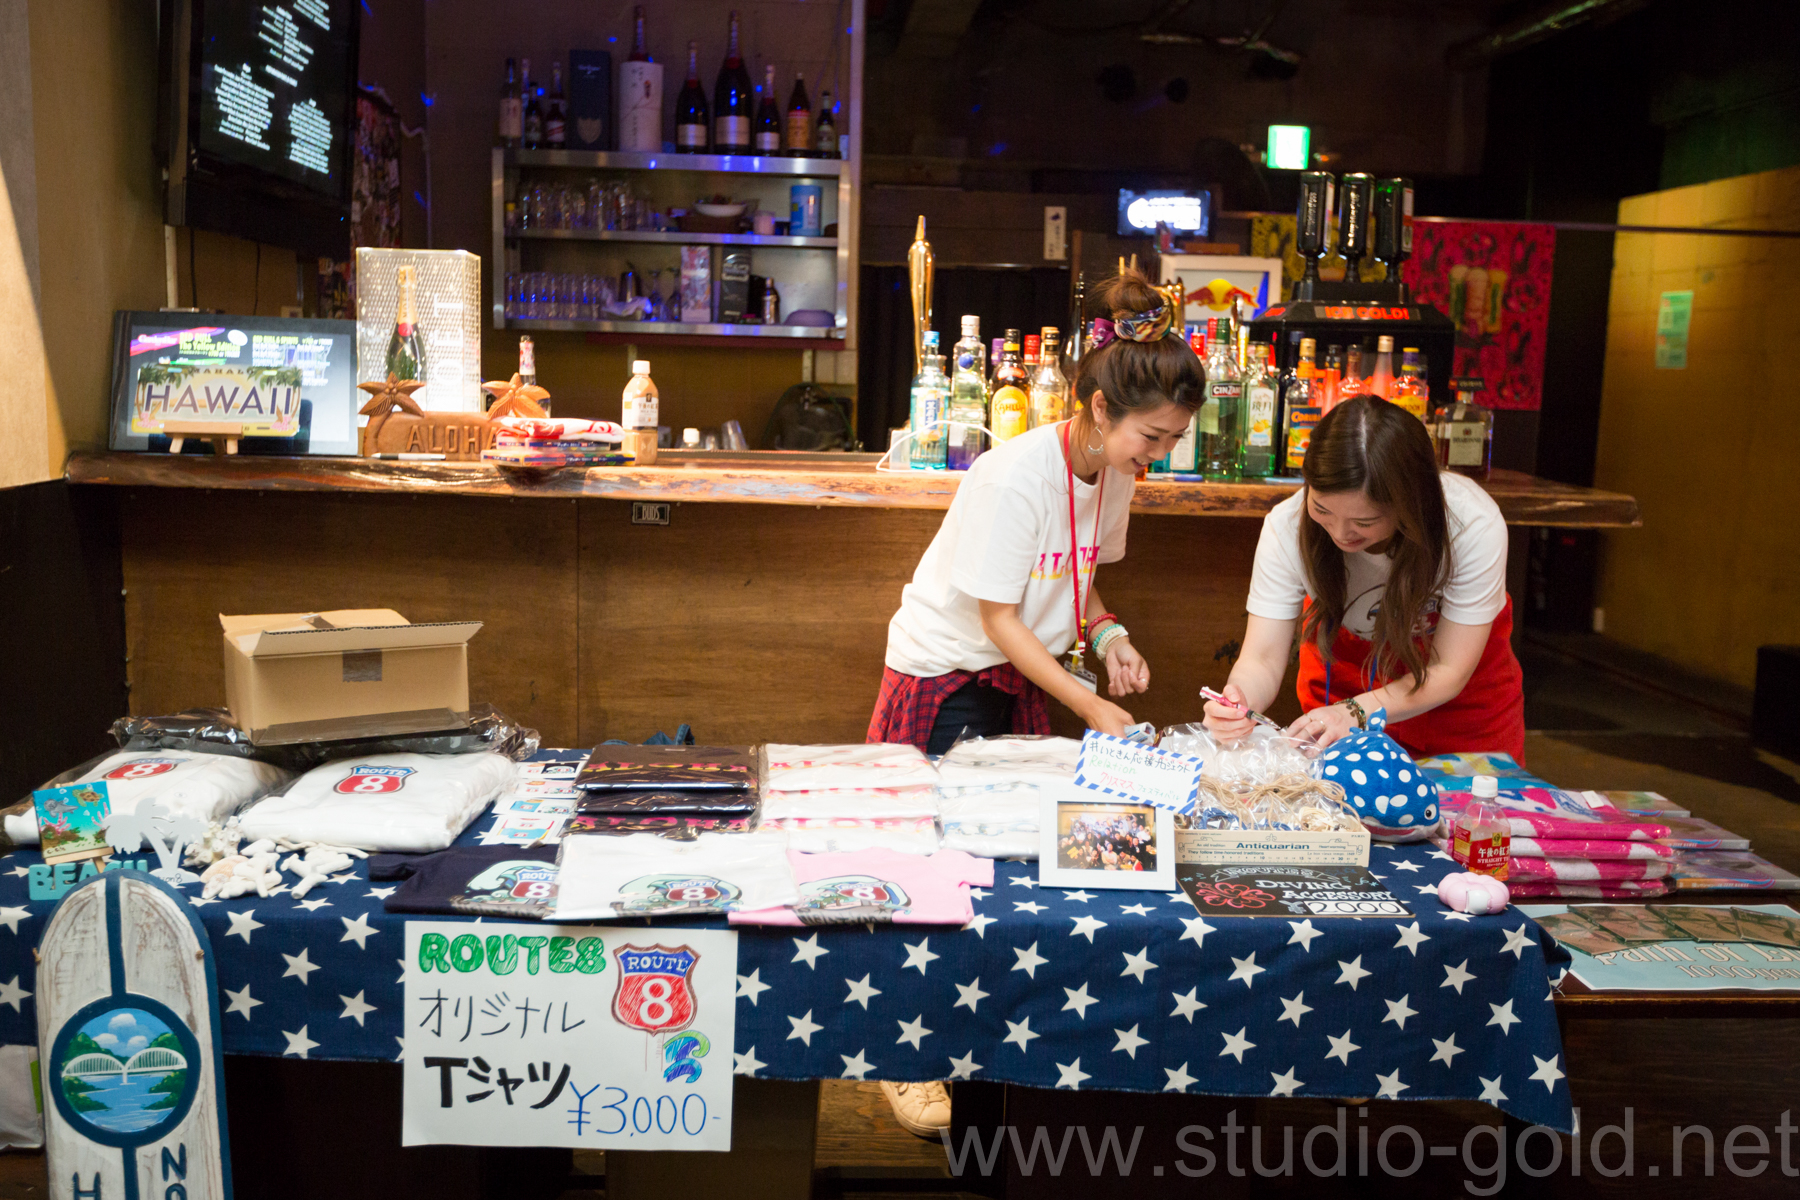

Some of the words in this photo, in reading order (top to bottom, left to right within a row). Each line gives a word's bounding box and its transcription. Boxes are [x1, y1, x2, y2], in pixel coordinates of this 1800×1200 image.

[1324, 306, 1355, 318] ICE
[144, 384, 293, 416] HAWAII
[642, 506, 660, 520] BUDS
[358, 767, 408, 776] ROUTE
[1089, 755, 1138, 775] Relation
[353, 775, 389, 792] 8
[1099, 771, 1135, 791] クリスマス
[1236, 842, 1310, 850] Antiquarian
[528, 882, 555, 899] 8
[671, 880, 714, 889] ROUTE
[1255, 879, 1352, 891] DIVING
[680, 887, 708, 901] 8
[852, 887, 876, 900] 8
[1282, 890, 1399, 901] ACCESSORY
[1307, 901, 1402, 914] 2000
[418, 933, 607, 976] ROUTE8
[627, 956, 689, 972] ROUTE
[639, 978, 674, 1025] 8
[419, 988, 586, 1042] オリジナル
[423, 1056, 571, 1110] Tシャツ
